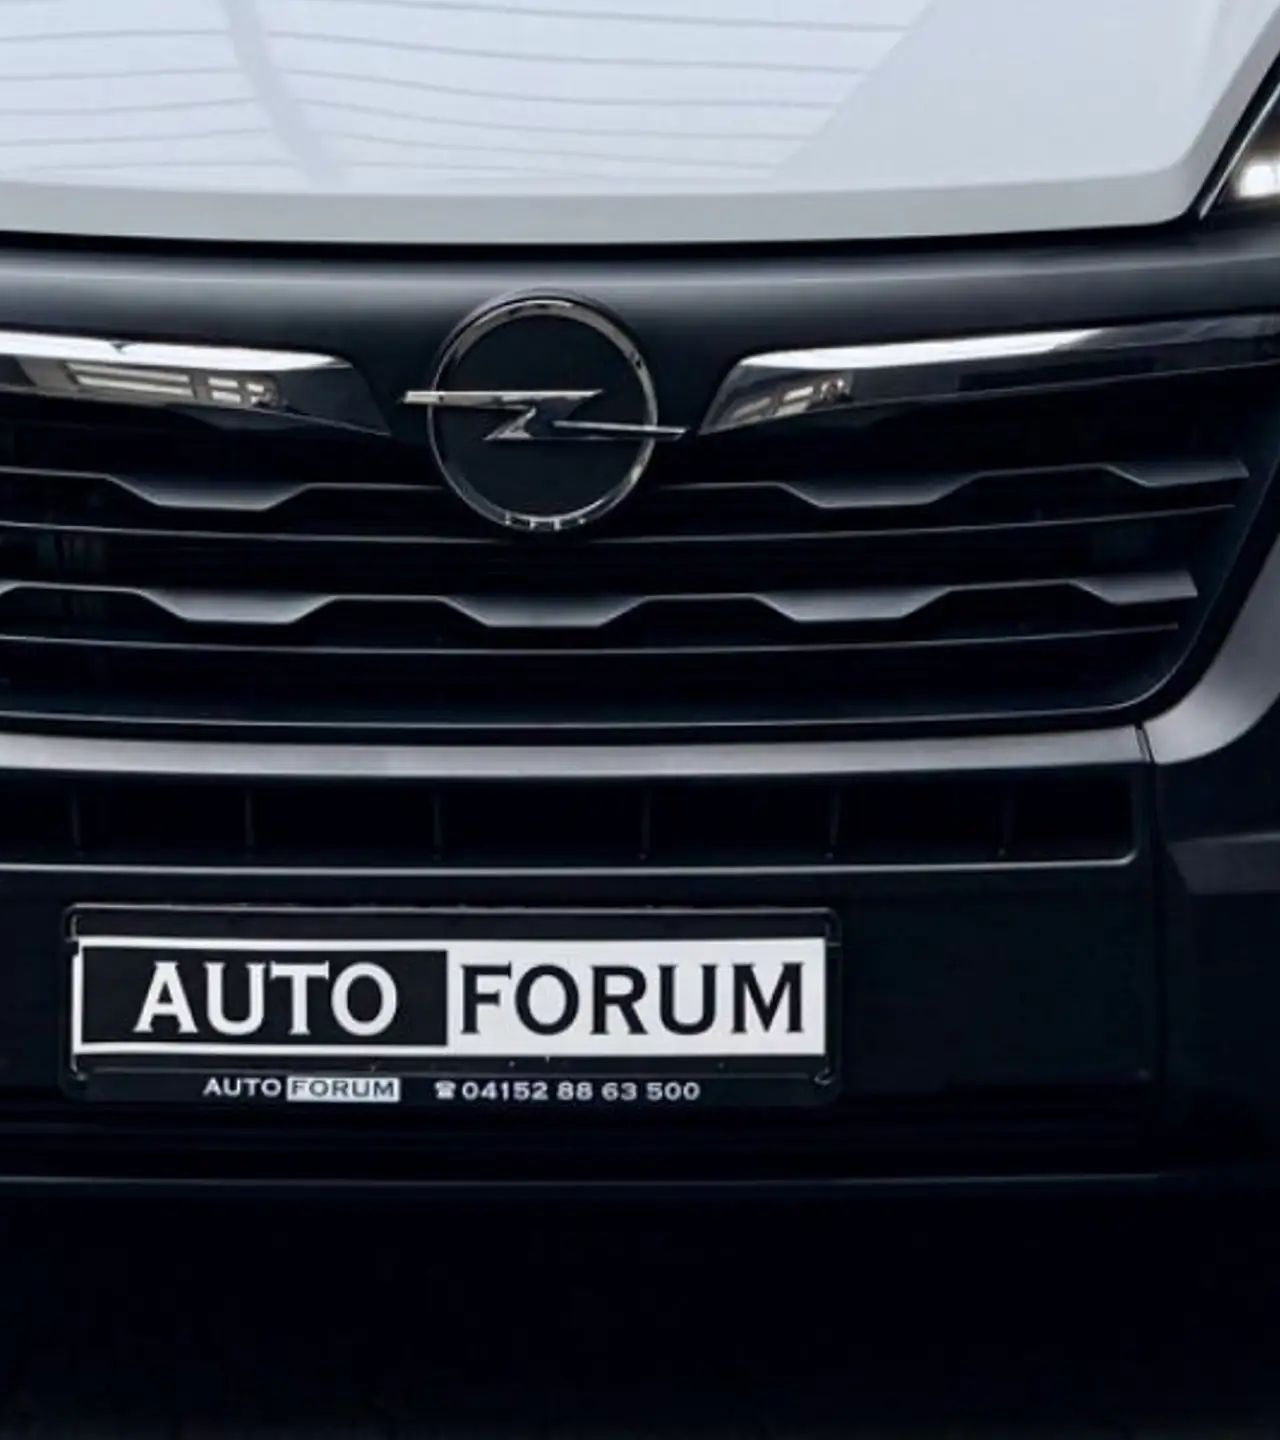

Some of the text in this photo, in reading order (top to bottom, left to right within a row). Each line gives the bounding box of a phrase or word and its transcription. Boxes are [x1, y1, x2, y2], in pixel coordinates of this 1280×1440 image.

[133, 961, 805, 1036] AUTO FORUM
[202, 1076, 701, 1101] AUTO FORUM 04152 88 63 500
